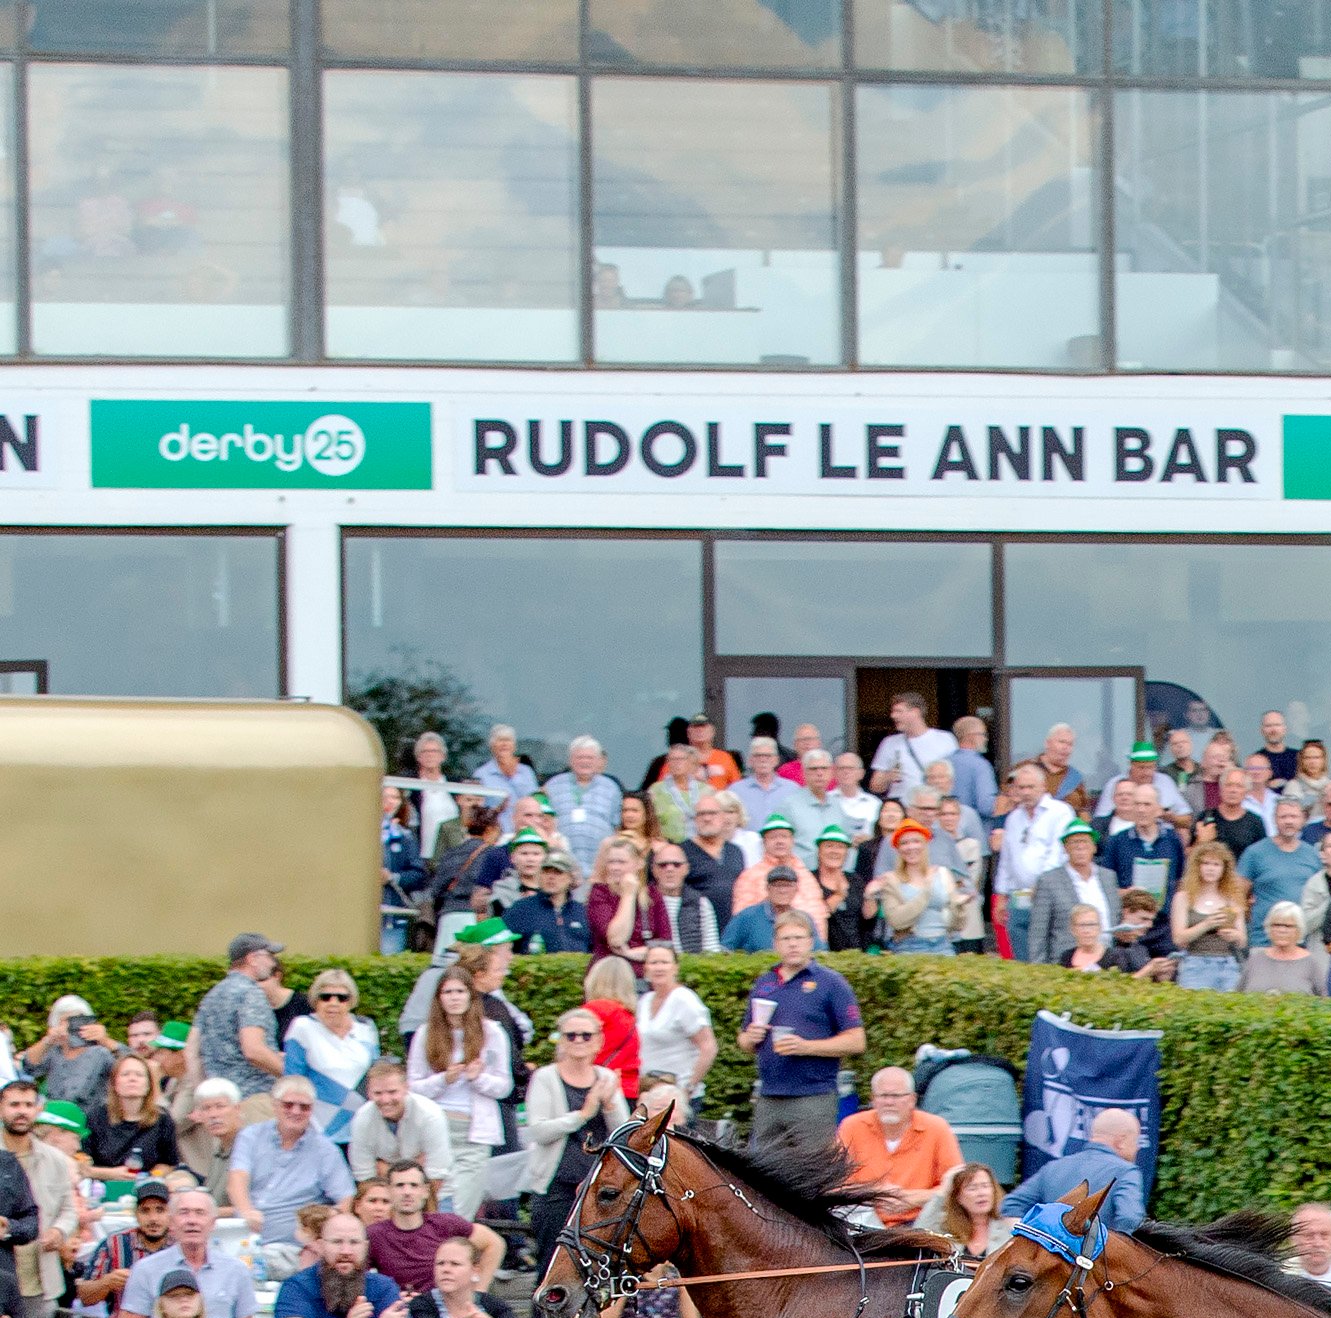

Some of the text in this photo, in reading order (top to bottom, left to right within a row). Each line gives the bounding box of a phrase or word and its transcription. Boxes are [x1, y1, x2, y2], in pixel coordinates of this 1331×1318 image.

[474, 419, 1257, 484] RUDOLF LE ANN BAR
